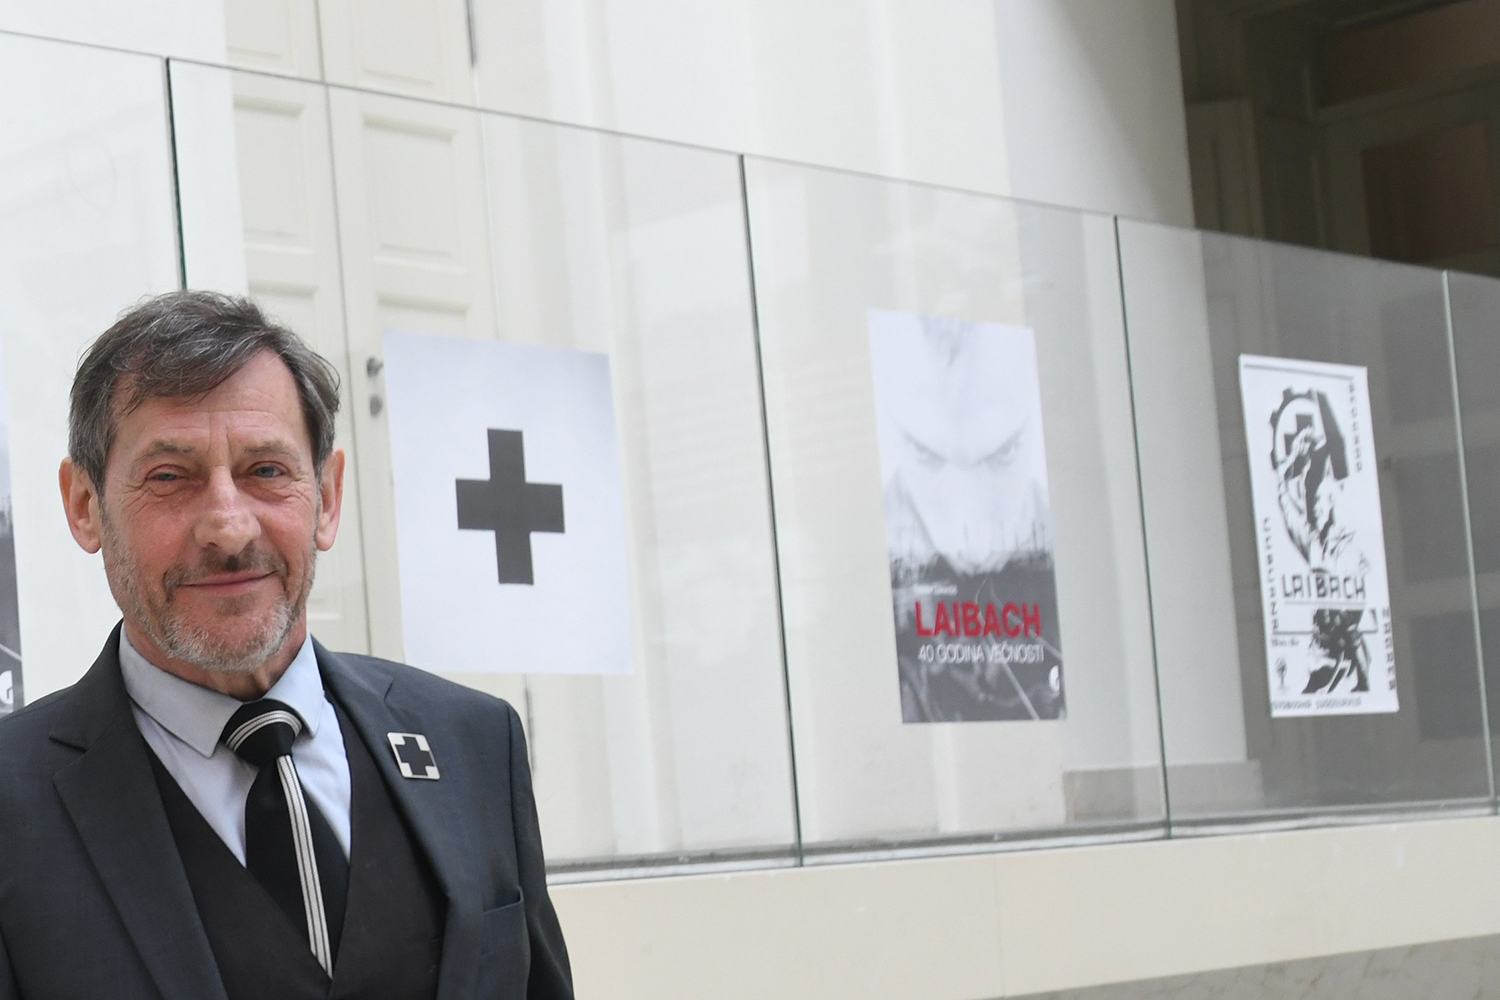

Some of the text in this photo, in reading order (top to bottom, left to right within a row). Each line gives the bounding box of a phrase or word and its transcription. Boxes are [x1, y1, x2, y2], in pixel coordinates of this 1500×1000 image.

[1282, 574, 1366, 599] LAIBACH
[915, 600, 1042, 638] LAIBACH
[917, 644, 935, 664] 40
[936, 643, 986, 664] GODINA
